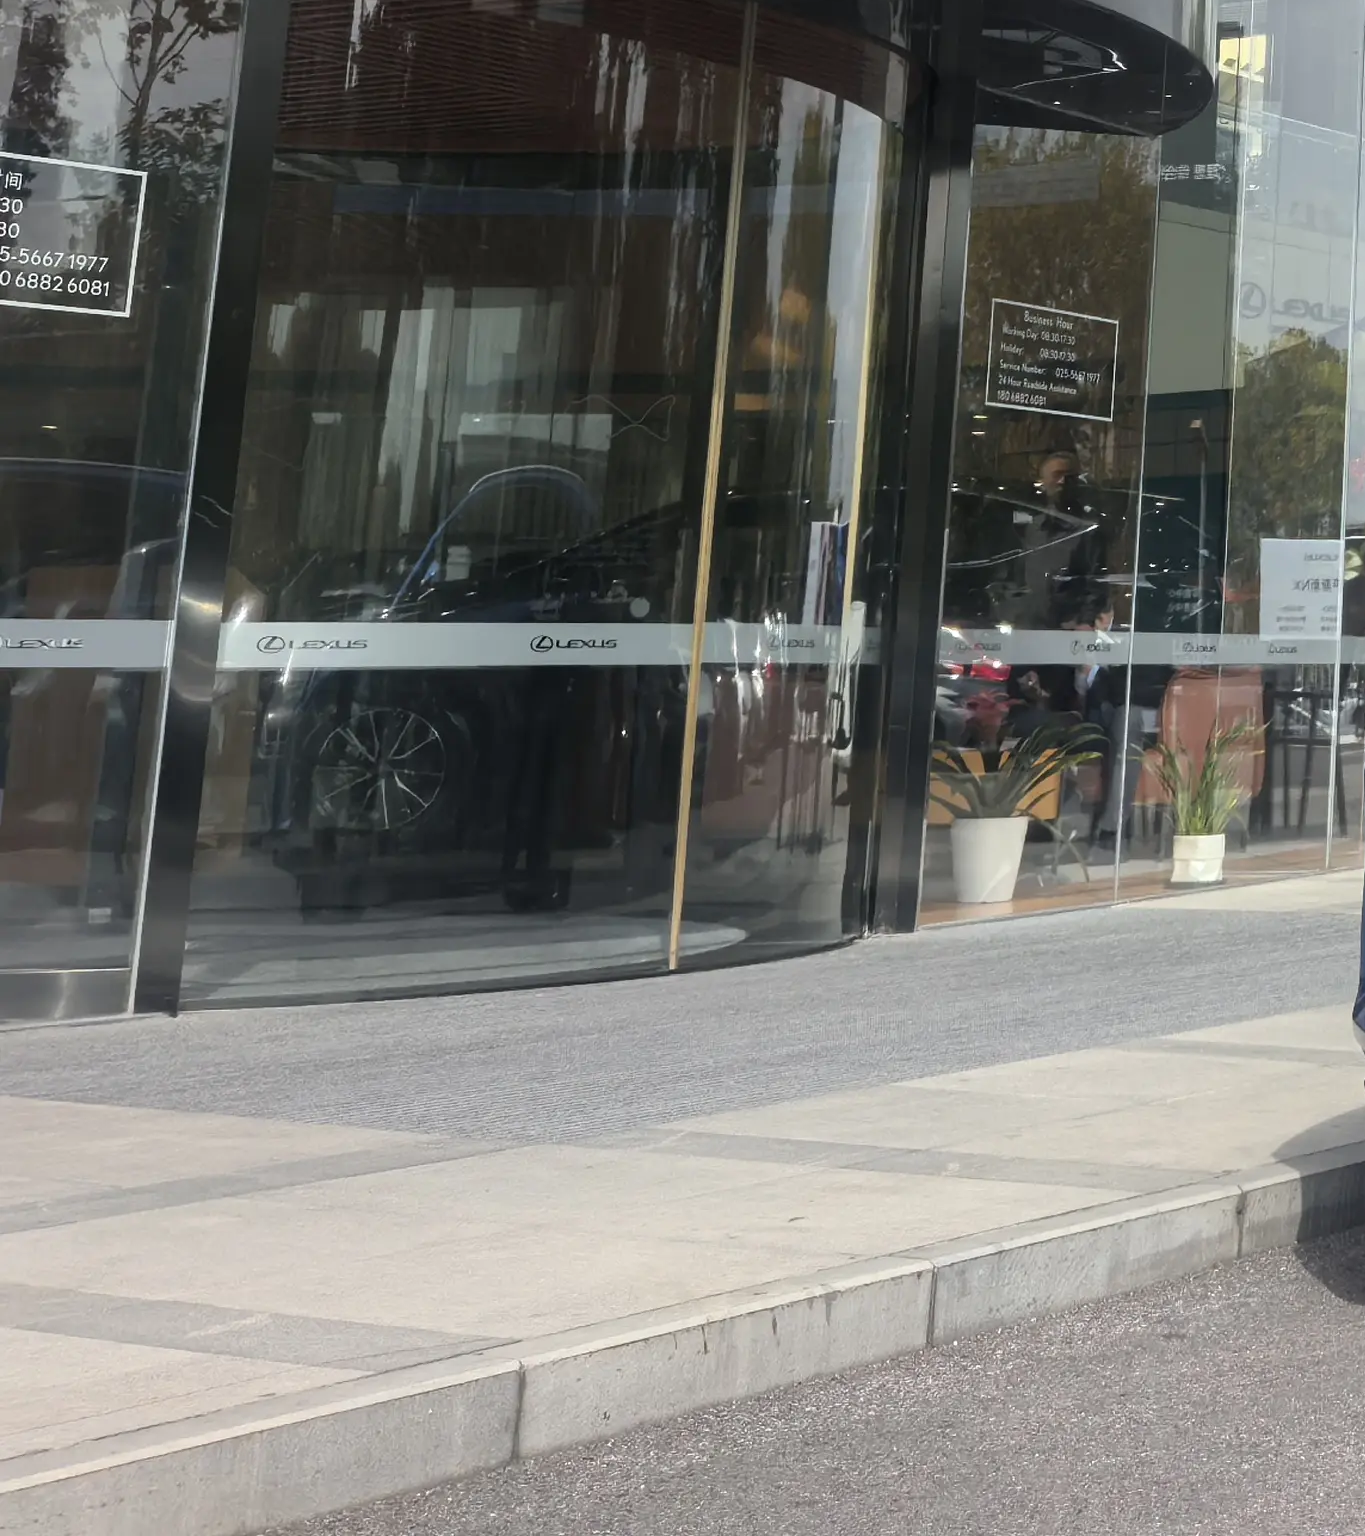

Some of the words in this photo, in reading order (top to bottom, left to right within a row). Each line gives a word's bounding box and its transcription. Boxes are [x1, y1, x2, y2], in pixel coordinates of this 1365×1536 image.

[15, 271, 64, 292] 6882
[67, 277, 111, 297] 6081
[1024, 310, 1053, 327] Business
[1056, 316, 1074, 331] Hour
[288, 639, 368, 650] LEXUS
[556, 638, 618, 649] LEXUS
